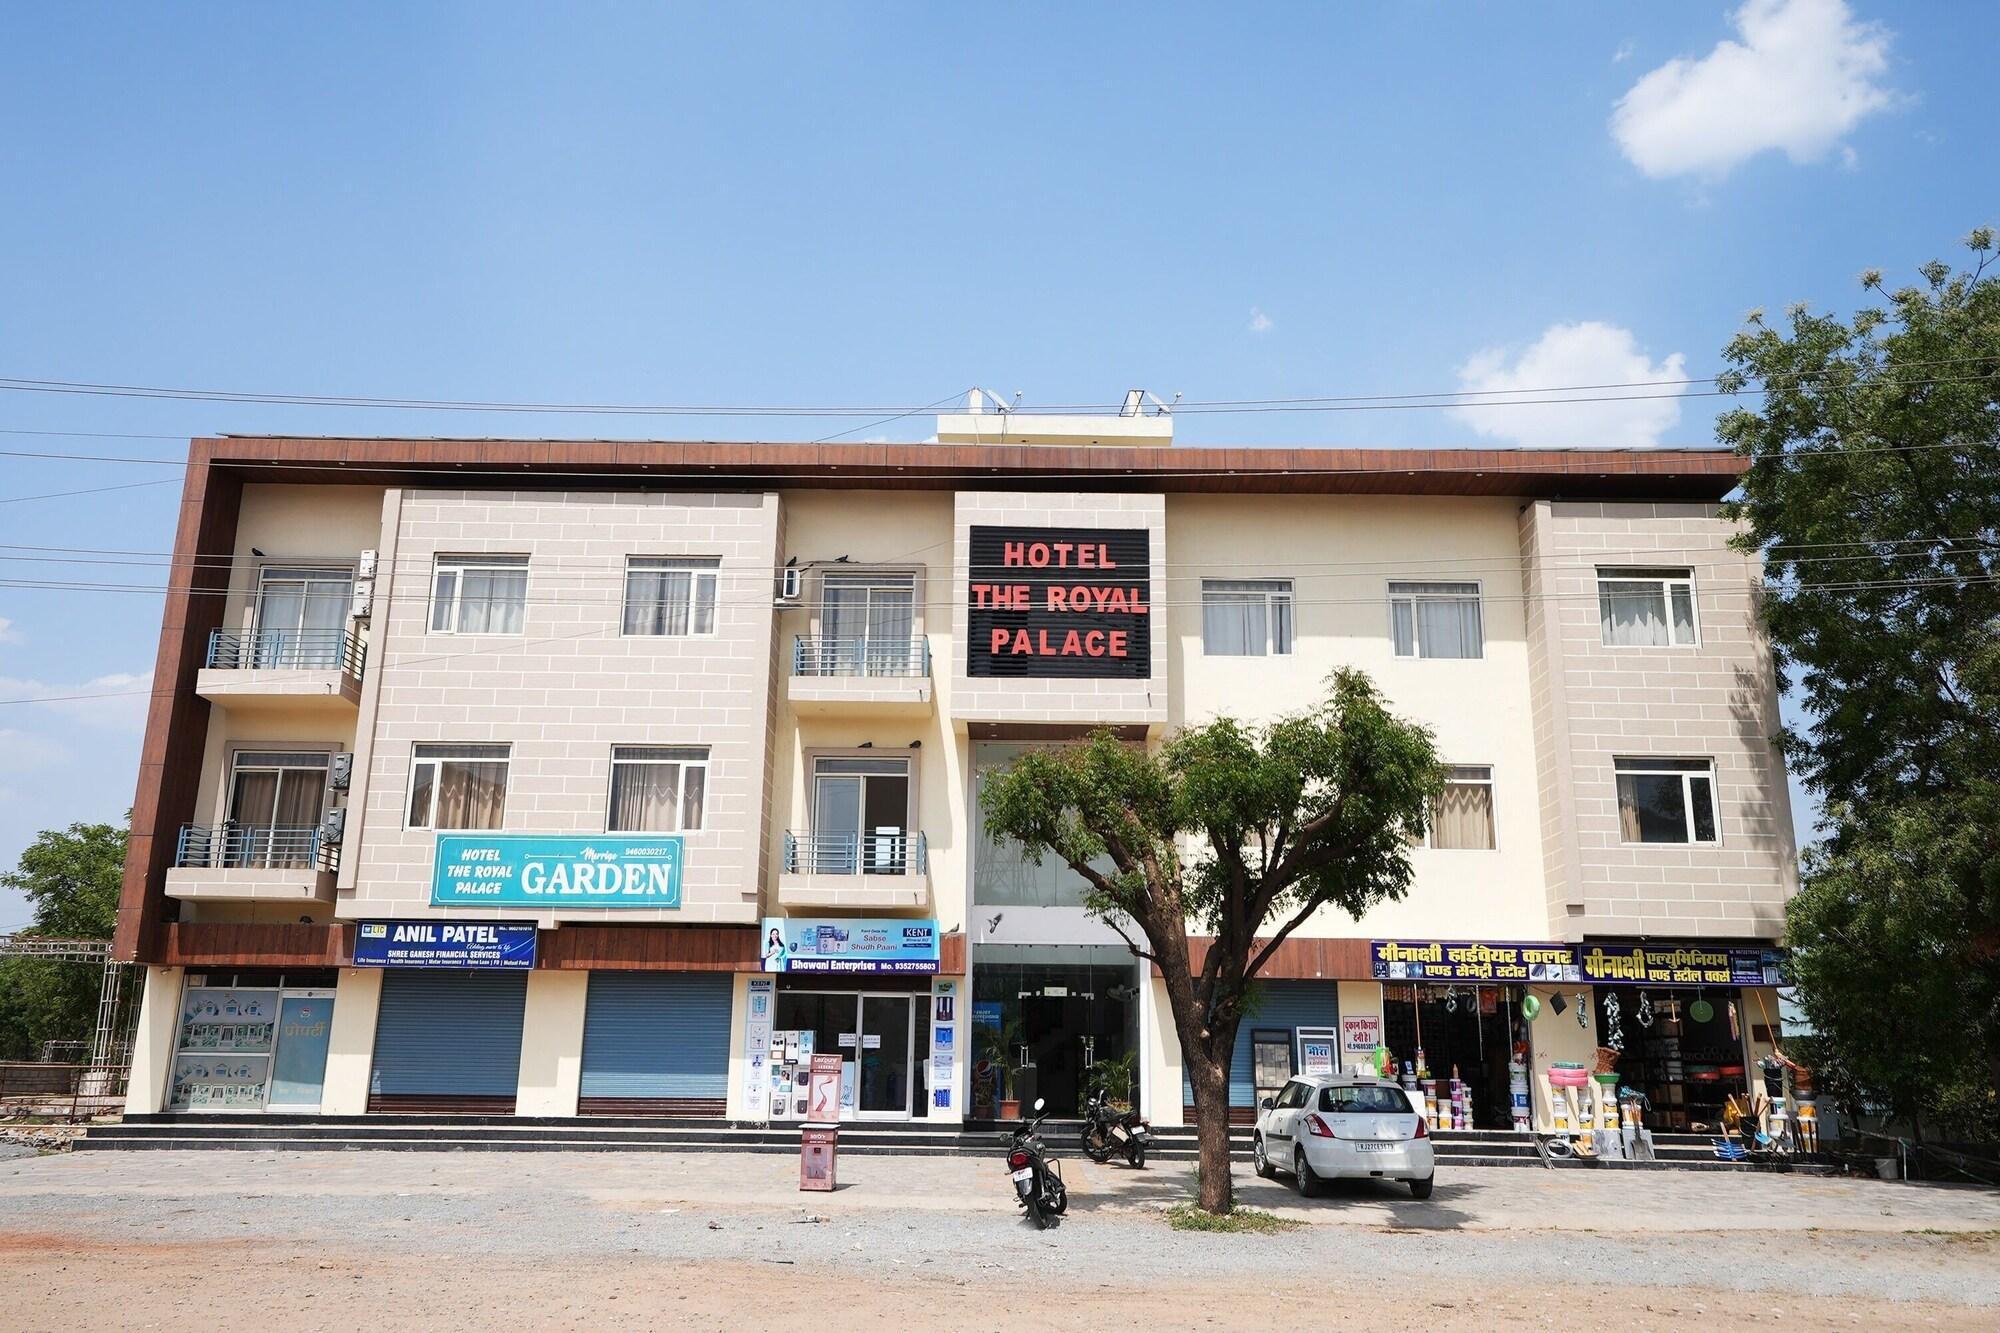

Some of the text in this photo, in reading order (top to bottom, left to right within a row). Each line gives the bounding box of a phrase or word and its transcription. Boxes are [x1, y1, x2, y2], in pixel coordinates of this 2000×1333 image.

[1003, 541, 1117, 569] HOTEL
[971, 584, 1148, 614] THE ROYAL
[991, 628, 1128, 657] PALACE
[461, 849, 501, 860] HOTEL
[447, 865, 513, 878] THE ROYAL
[520, 862, 672, 896] GARDEN
[455, 882, 503, 895] PALACE
[372, 926, 385, 934] LIC
[393, 925, 499, 943] ANIL PATEL
[906, 928, 928, 937] KENT
[863, 934, 887, 942] Sabse
[851, 943, 875, 951] Shudh
[876, 943, 898, 951] Paani
[1376, 943, 1574, 964] मीनाक्षी हार्डवेयर कलर
[388, 950, 500, 959] SHREE GANESH FINANCIAL SERVICES
[1646, 949, 1728, 968] एल्युमिनियम
[791, 959, 828, 970] Bhawani
[831, 960, 876, 972] Enterprises
[1424, 964, 1452, 976] एण्ड
[1495, 964, 1527, 978] स्टोर
[1583, 948, 1646, 980] मीनाक्षी
[1648, 969, 1671, 981] एण्ड
[1673, 968, 1702, 982] स्टील
